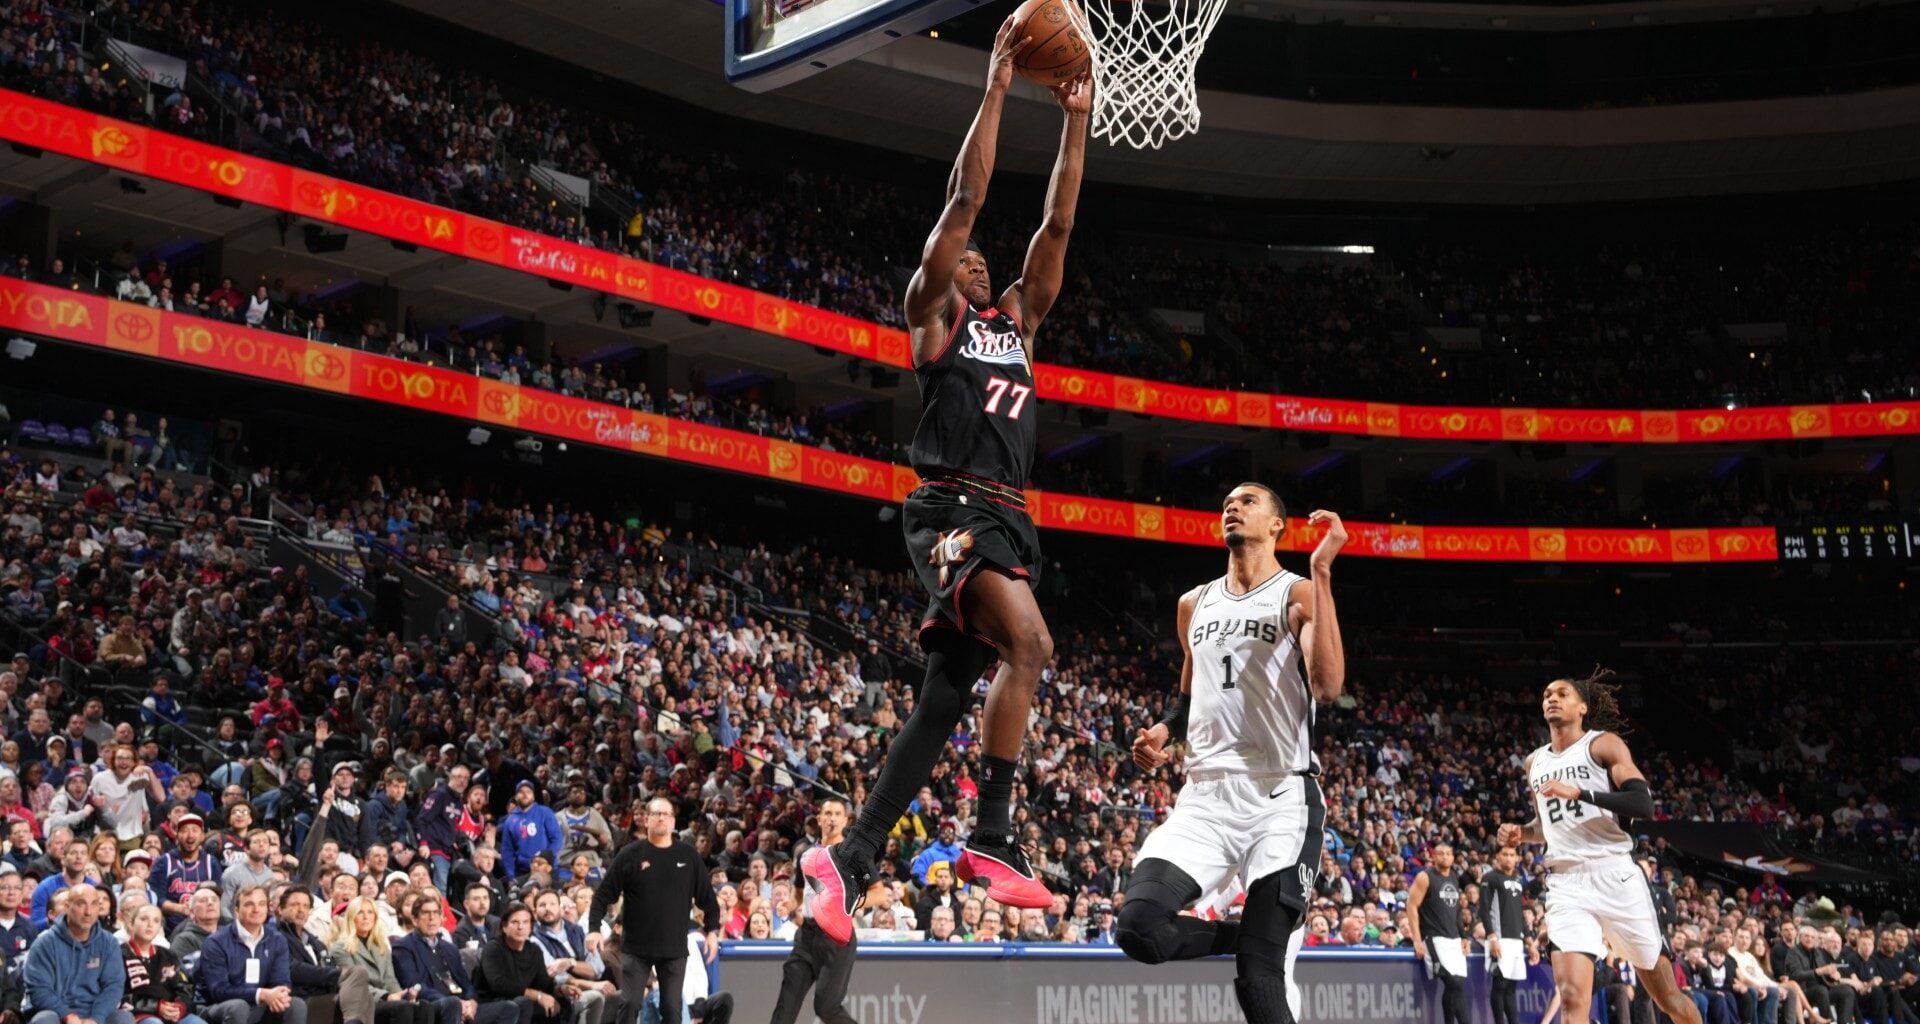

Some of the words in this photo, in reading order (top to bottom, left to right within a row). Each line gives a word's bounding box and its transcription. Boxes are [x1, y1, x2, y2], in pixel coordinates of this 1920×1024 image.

[362, 363, 468, 406] TOYOTA
[984, 375, 1032, 420] 77
[809, 457, 887, 491] TOYOTA
[1049, 502, 1128, 527] TOYOTA
[1432, 534, 1522, 552] TOYOTA
[1573, 535, 1663, 554] TOYOTA
[1784, 536, 1804, 547] PHI
[1840, 535, 1848, 546] 0
[1864, 535, 1871, 545] 2
[1888, 534, 1896, 545] 0
[1784, 548, 1807, 558] SAS
[1843, 547, 1849, 557] 3
[1866, 546, 1872, 557] 2
[1193, 618, 1277, 648] SPURS
[1222, 655, 1236, 690] 1
[1532, 765, 1591, 794] SPURS
[1546, 797, 1584, 824] 24
[126, 959, 150, 989] PHI
[1037, 984, 1139, 1024] IMAGINE
[1142, 984, 1187, 1023] THE
[1314, 982, 1354, 1020] ONE
[1355, 982, 1422, 1019] PLACE.
